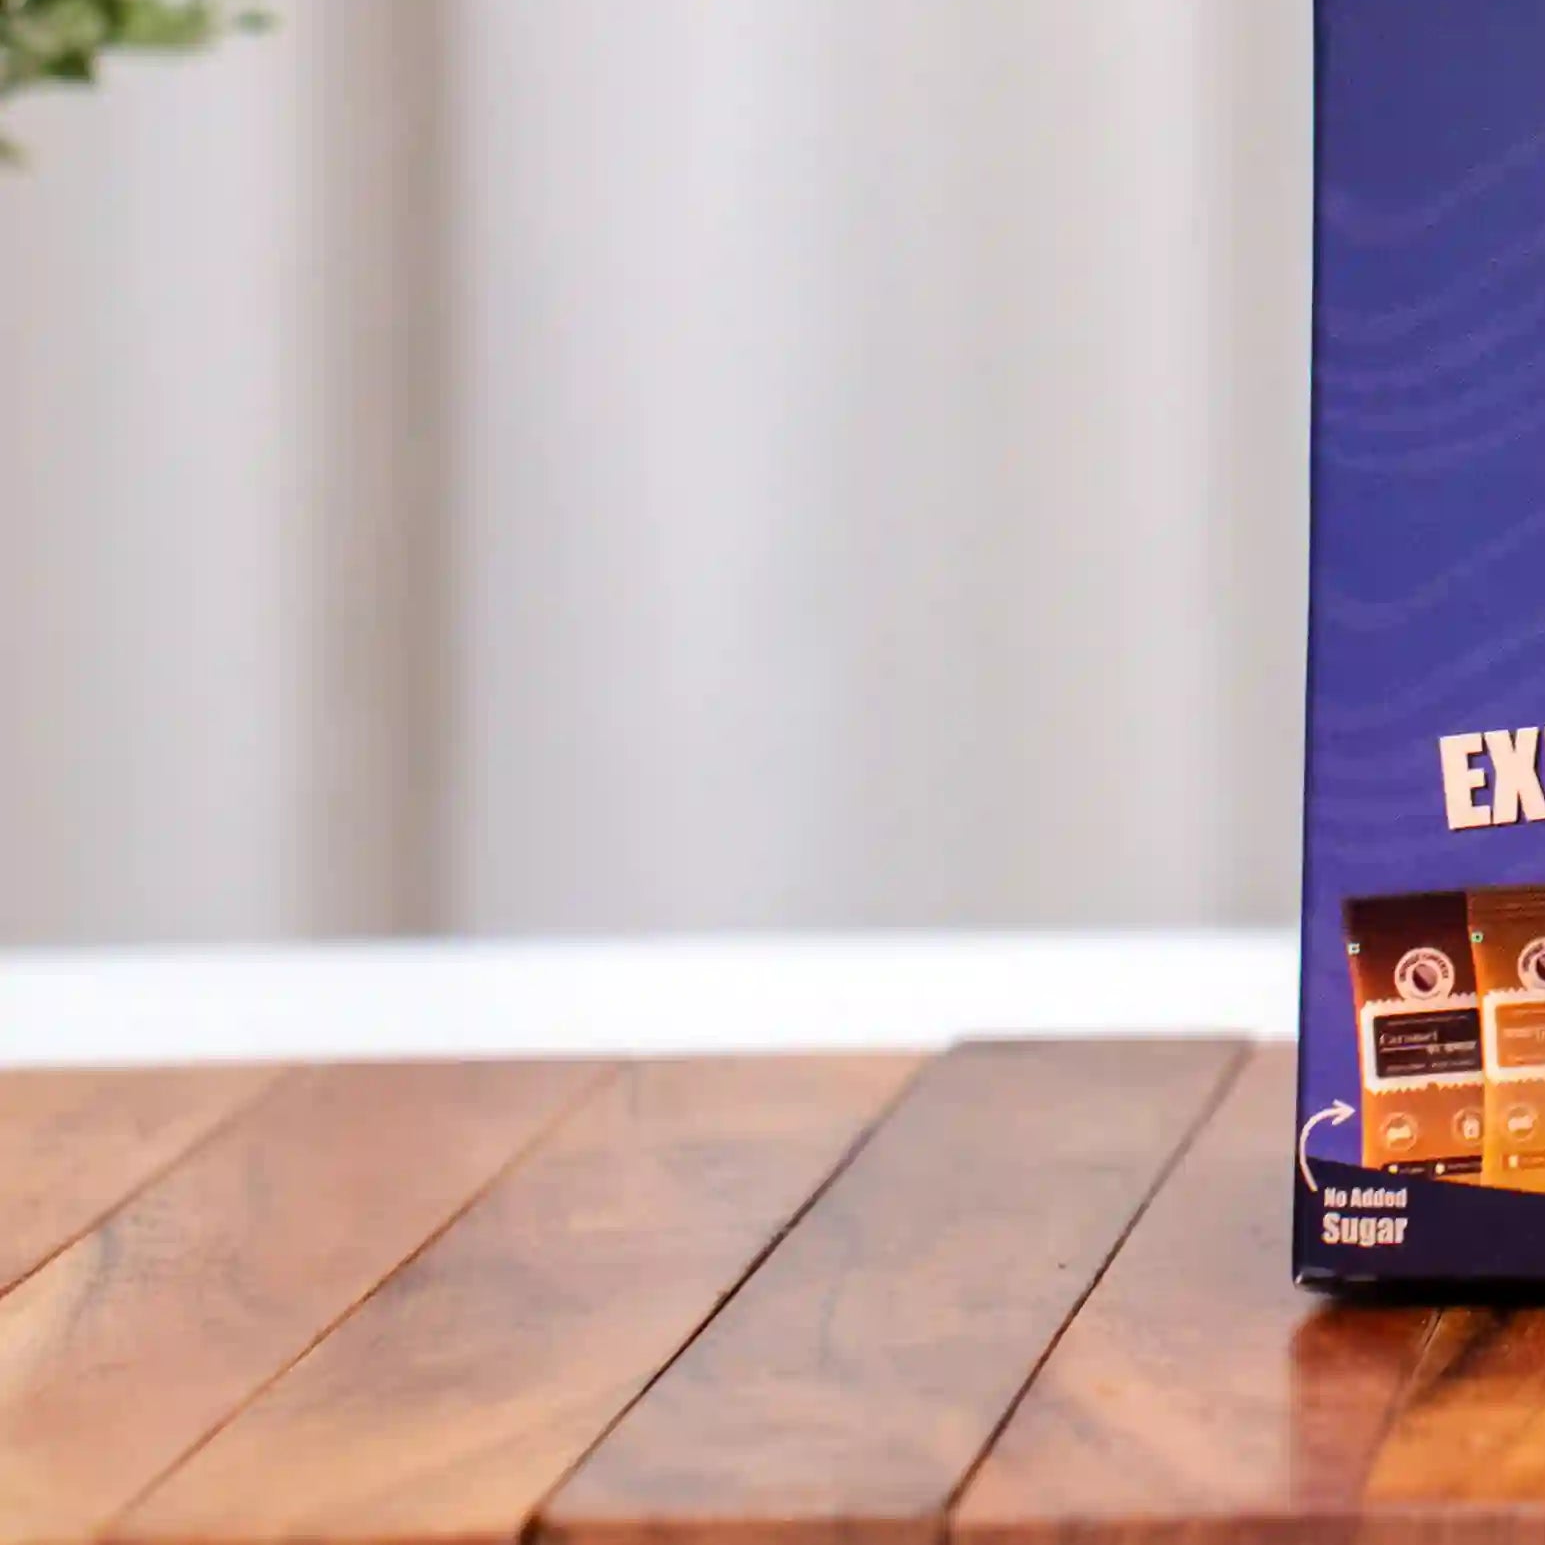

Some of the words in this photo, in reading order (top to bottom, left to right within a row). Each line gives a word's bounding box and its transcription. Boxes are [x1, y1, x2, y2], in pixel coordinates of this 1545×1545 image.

[1323, 1186, 1347, 1208] No
[1350, 1186, 1408, 1208] Added
[1321, 1212, 1408, 1248] Sugar
